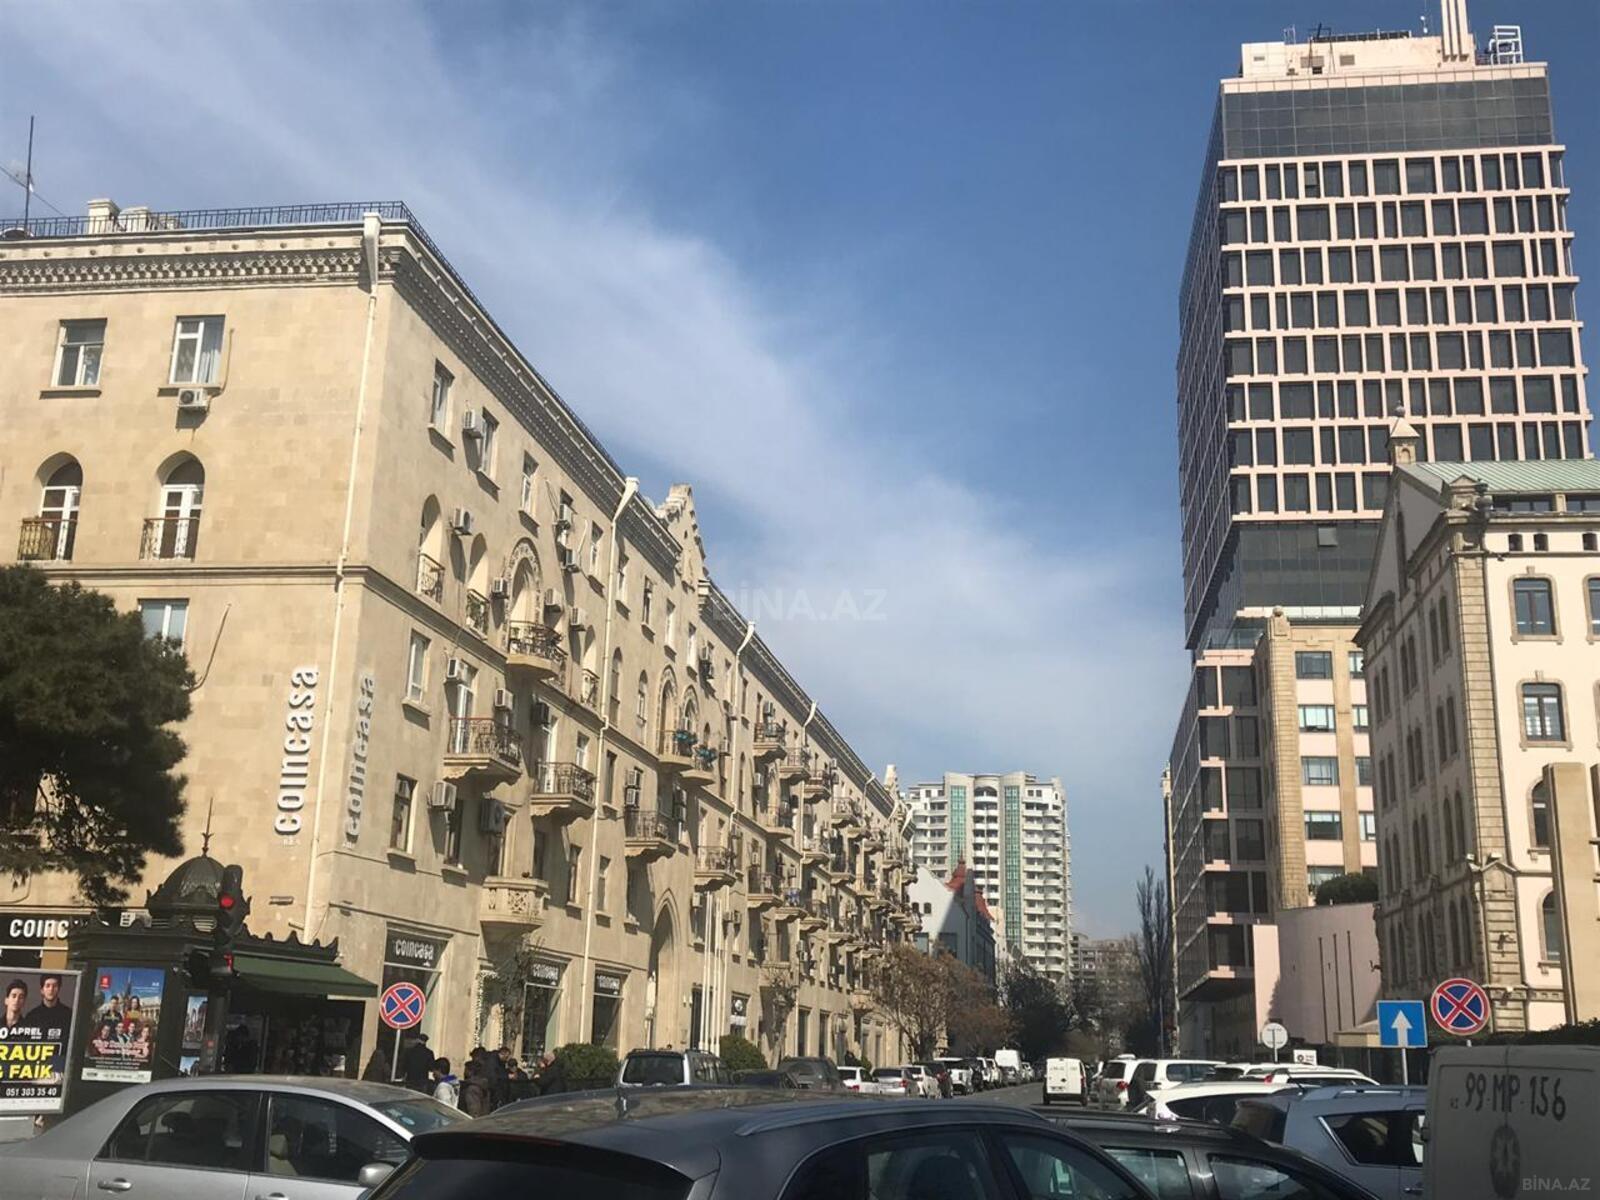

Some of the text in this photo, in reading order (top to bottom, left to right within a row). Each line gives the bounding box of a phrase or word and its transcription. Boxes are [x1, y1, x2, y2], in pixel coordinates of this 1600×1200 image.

[274, 665, 319, 836] coincasa
[10, 919, 69, 938] coinc
[10, 1027, 42, 1036] APREL
[0, 1045, 54, 1061] RAUF
[5, 1088, 19, 1097] 051
